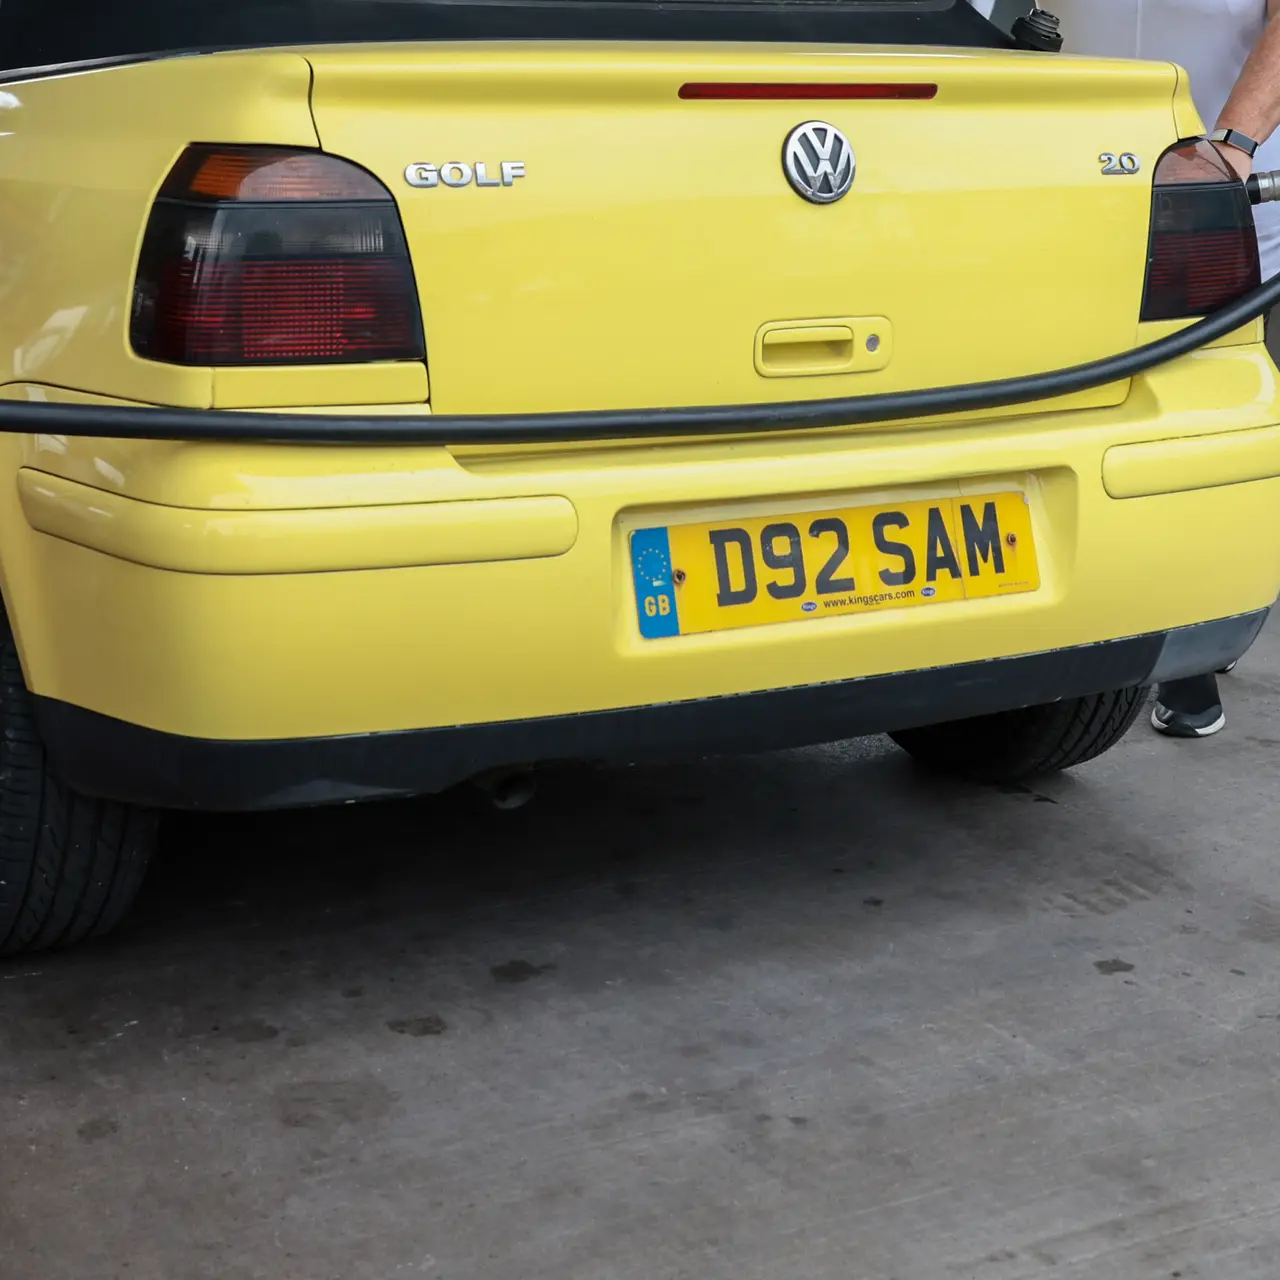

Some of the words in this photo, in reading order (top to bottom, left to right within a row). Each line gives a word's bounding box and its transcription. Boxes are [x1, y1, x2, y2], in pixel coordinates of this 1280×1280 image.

[403, 160, 526, 188] GOLF
[708, 516, 856, 607] D92
[872, 500, 1006, 587] SAM
[643, 593, 671, 618] GB
[823, 588, 916, 609] www.kingscars.com
